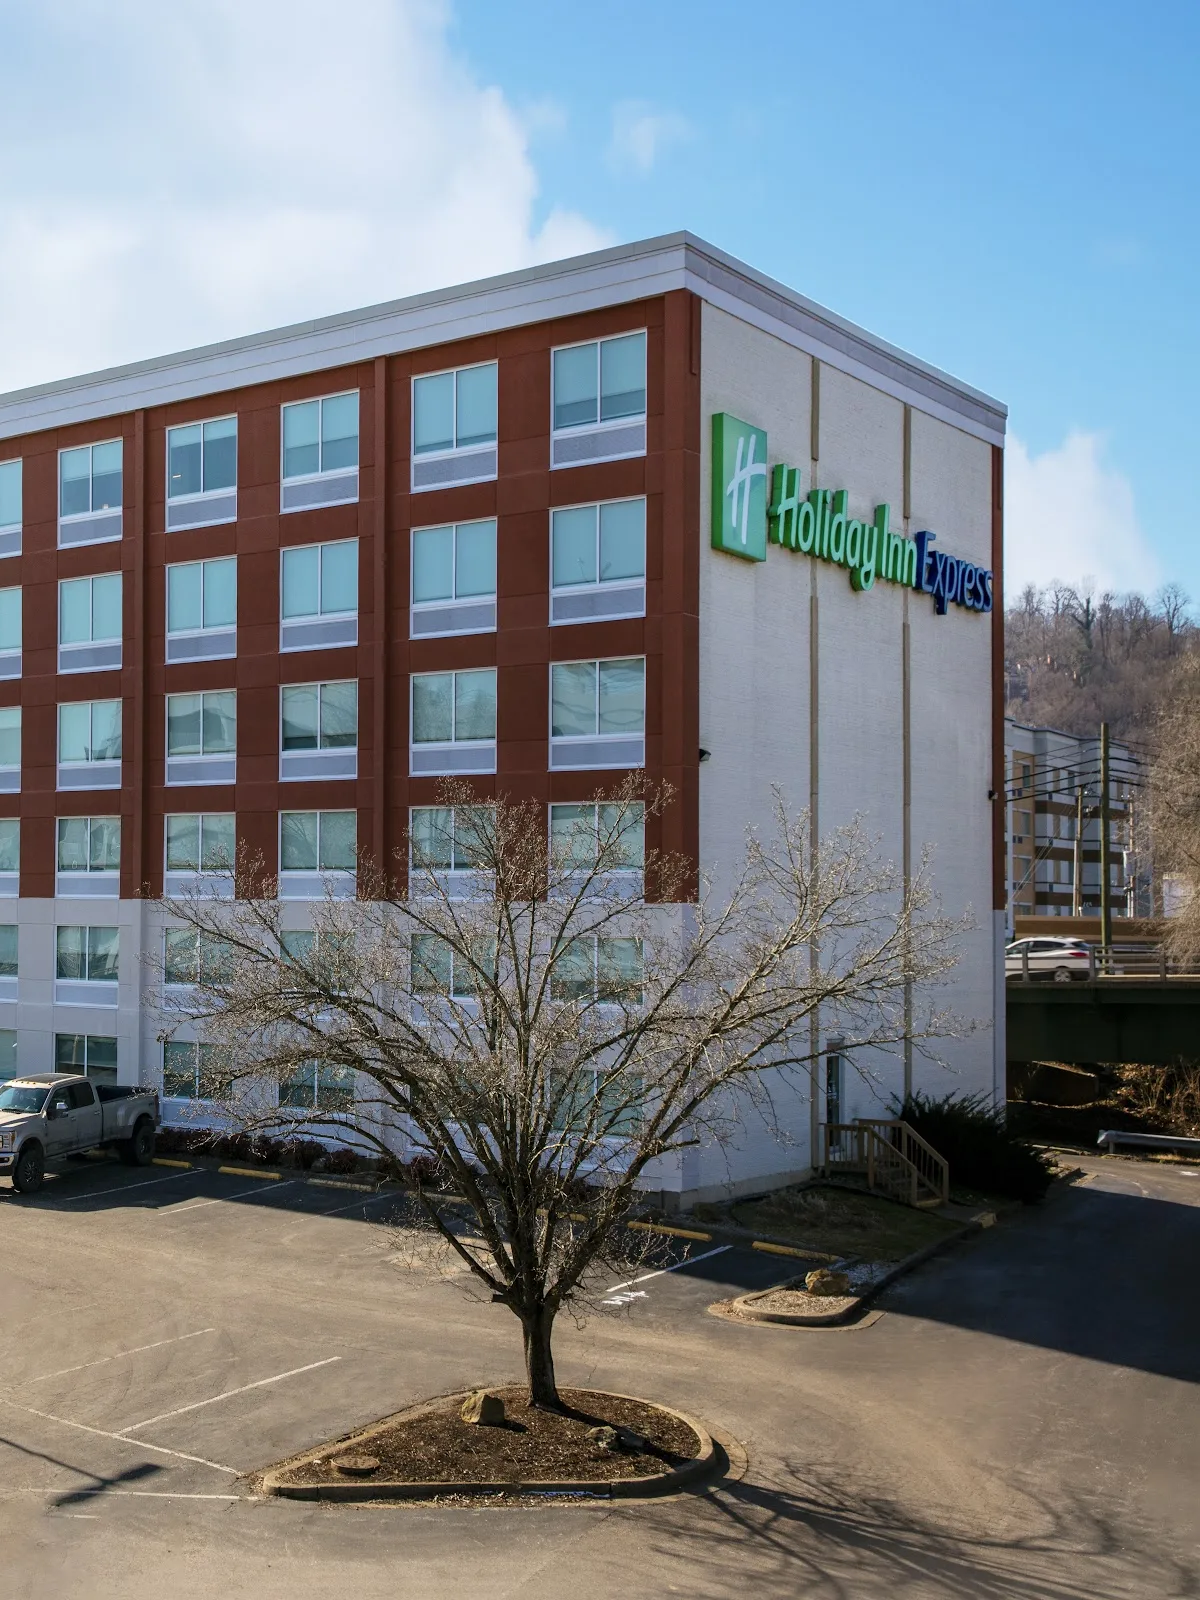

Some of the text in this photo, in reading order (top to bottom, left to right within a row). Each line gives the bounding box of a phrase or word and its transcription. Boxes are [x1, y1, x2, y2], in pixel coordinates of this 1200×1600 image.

[726, 434, 766, 545] H
[769, 463, 993, 615] Holiday Inn Express
